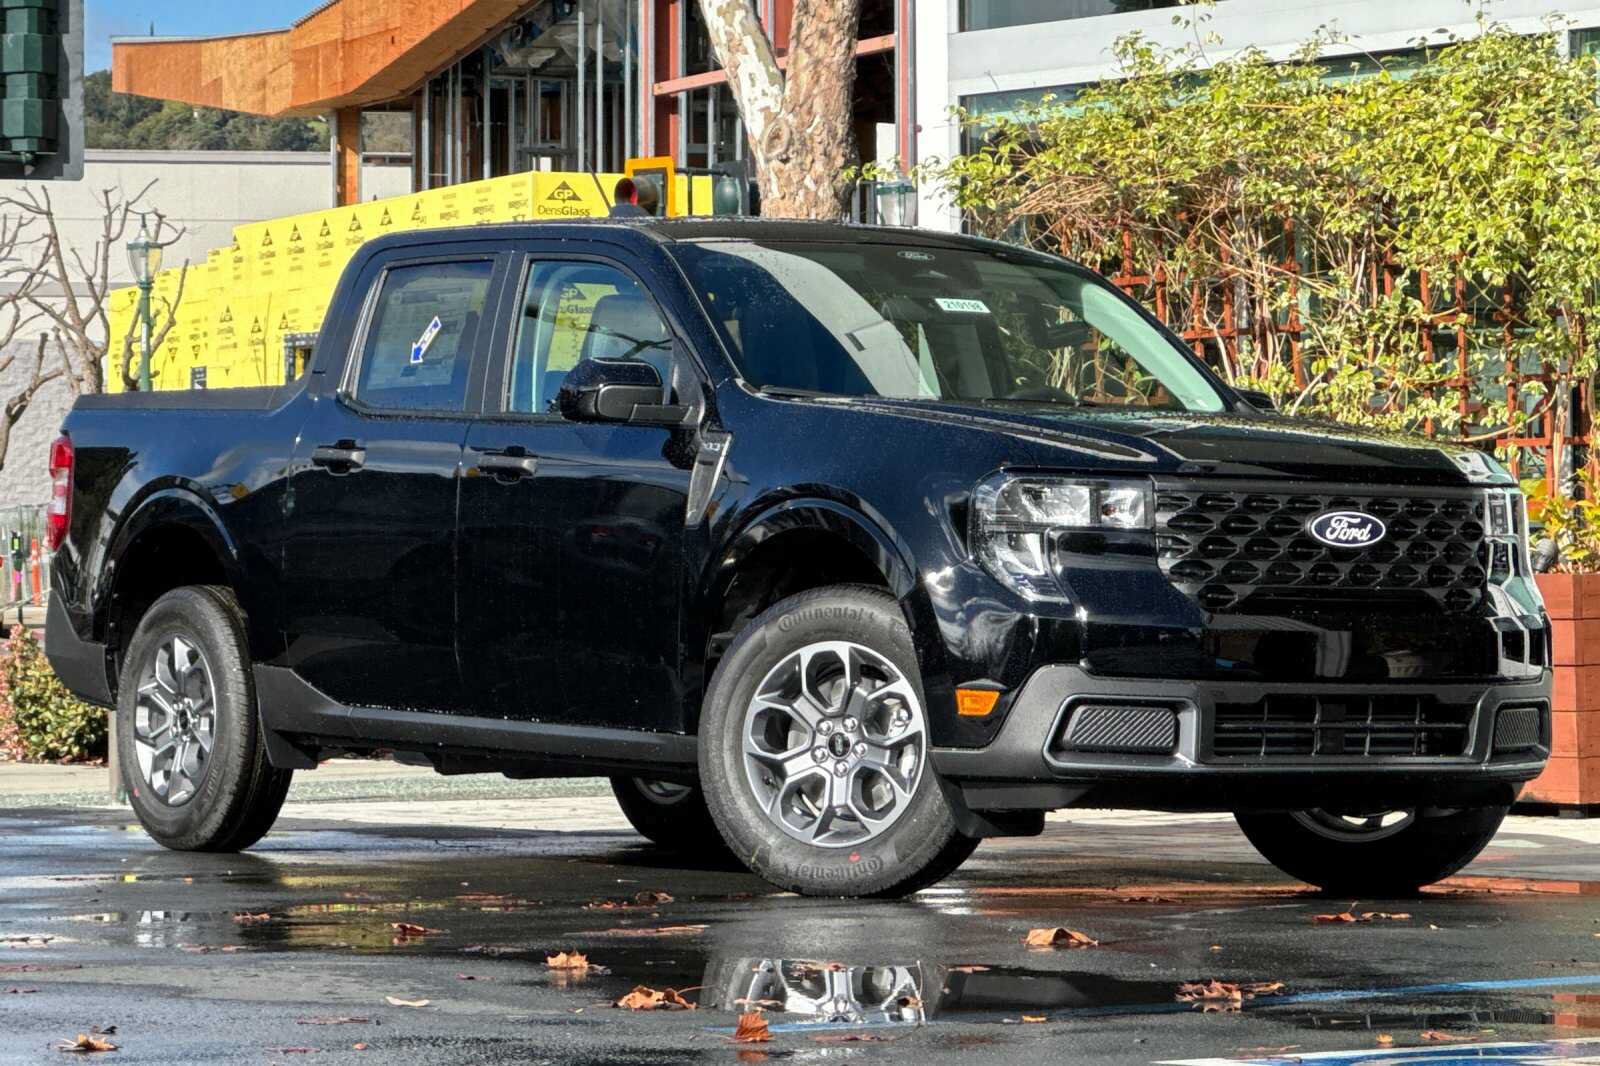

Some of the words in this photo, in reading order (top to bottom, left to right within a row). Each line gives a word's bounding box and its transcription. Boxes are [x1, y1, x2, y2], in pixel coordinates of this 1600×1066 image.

[553, 189, 573, 200] GP
[537, 204, 591, 217] DensGlass
[1325, 516, 1372, 541] Ford
[778, 606, 865, 632] Continental
